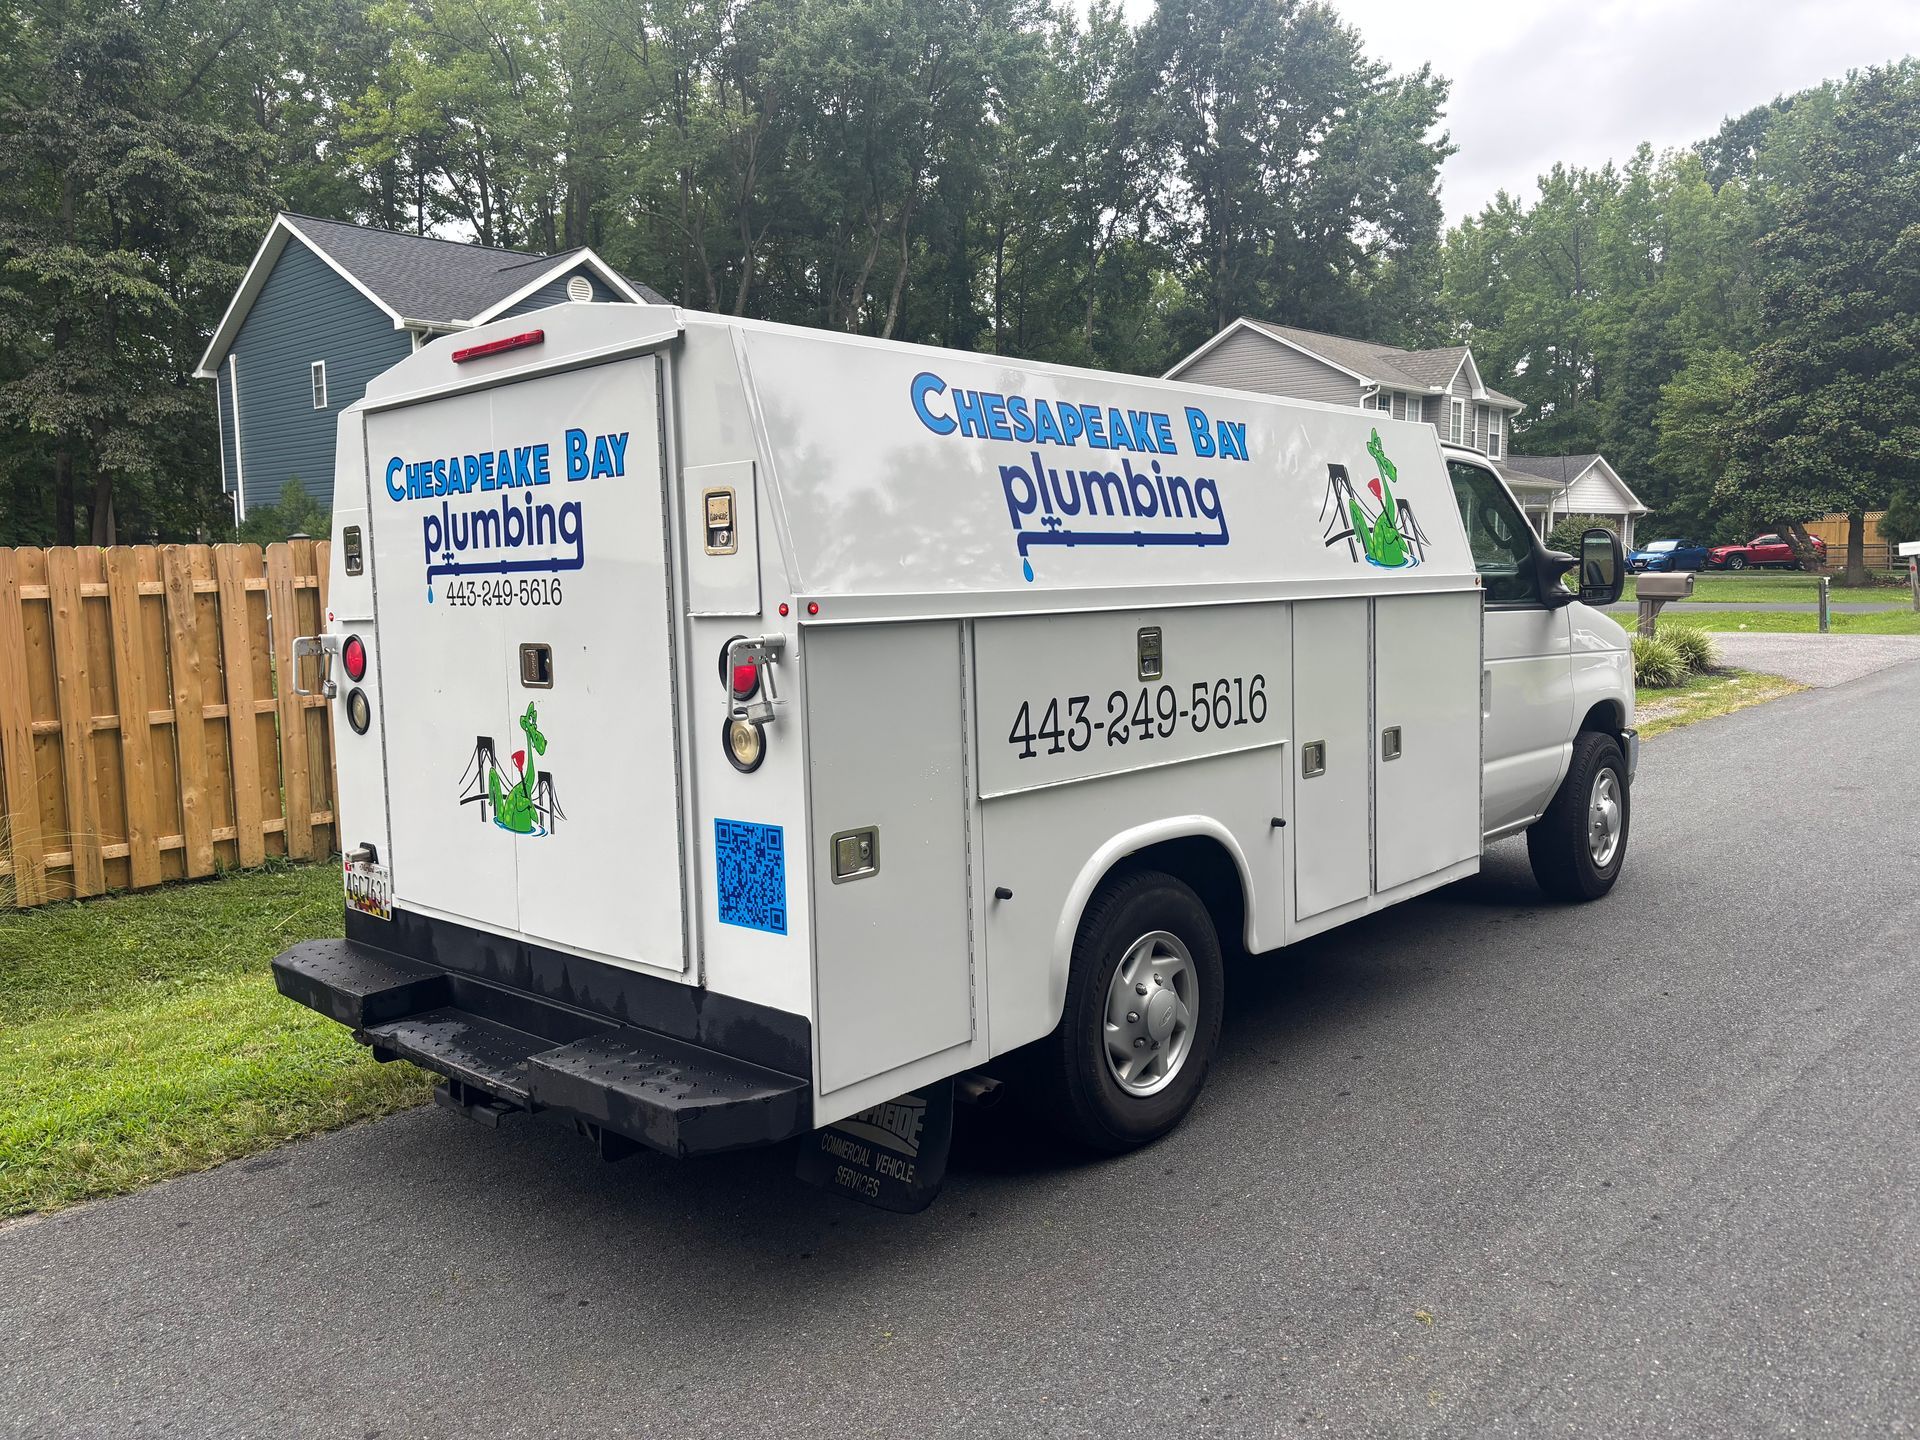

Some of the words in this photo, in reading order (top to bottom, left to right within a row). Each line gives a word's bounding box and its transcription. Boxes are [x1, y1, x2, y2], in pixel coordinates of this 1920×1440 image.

[910, 371, 1177, 455] CHESAPEAKE
[1184, 406, 1250, 461] BAY
[386, 443, 551, 502] CHESAPEAKE
[565, 428, 629, 482] BAY
[998, 451, 1230, 546] plumbing
[423, 491, 584, 575] plumbing
[446, 578, 563, 606] 443-249-5616
[1008, 674, 1267, 759] 443-249-5616
[821, 1133, 871, 1168] COMMERCIAL
[875, 1152, 915, 1184] VEHICLE
[850, 1102, 926, 1150] PHEIDE
[835, 1165, 880, 1198] SERVICES
